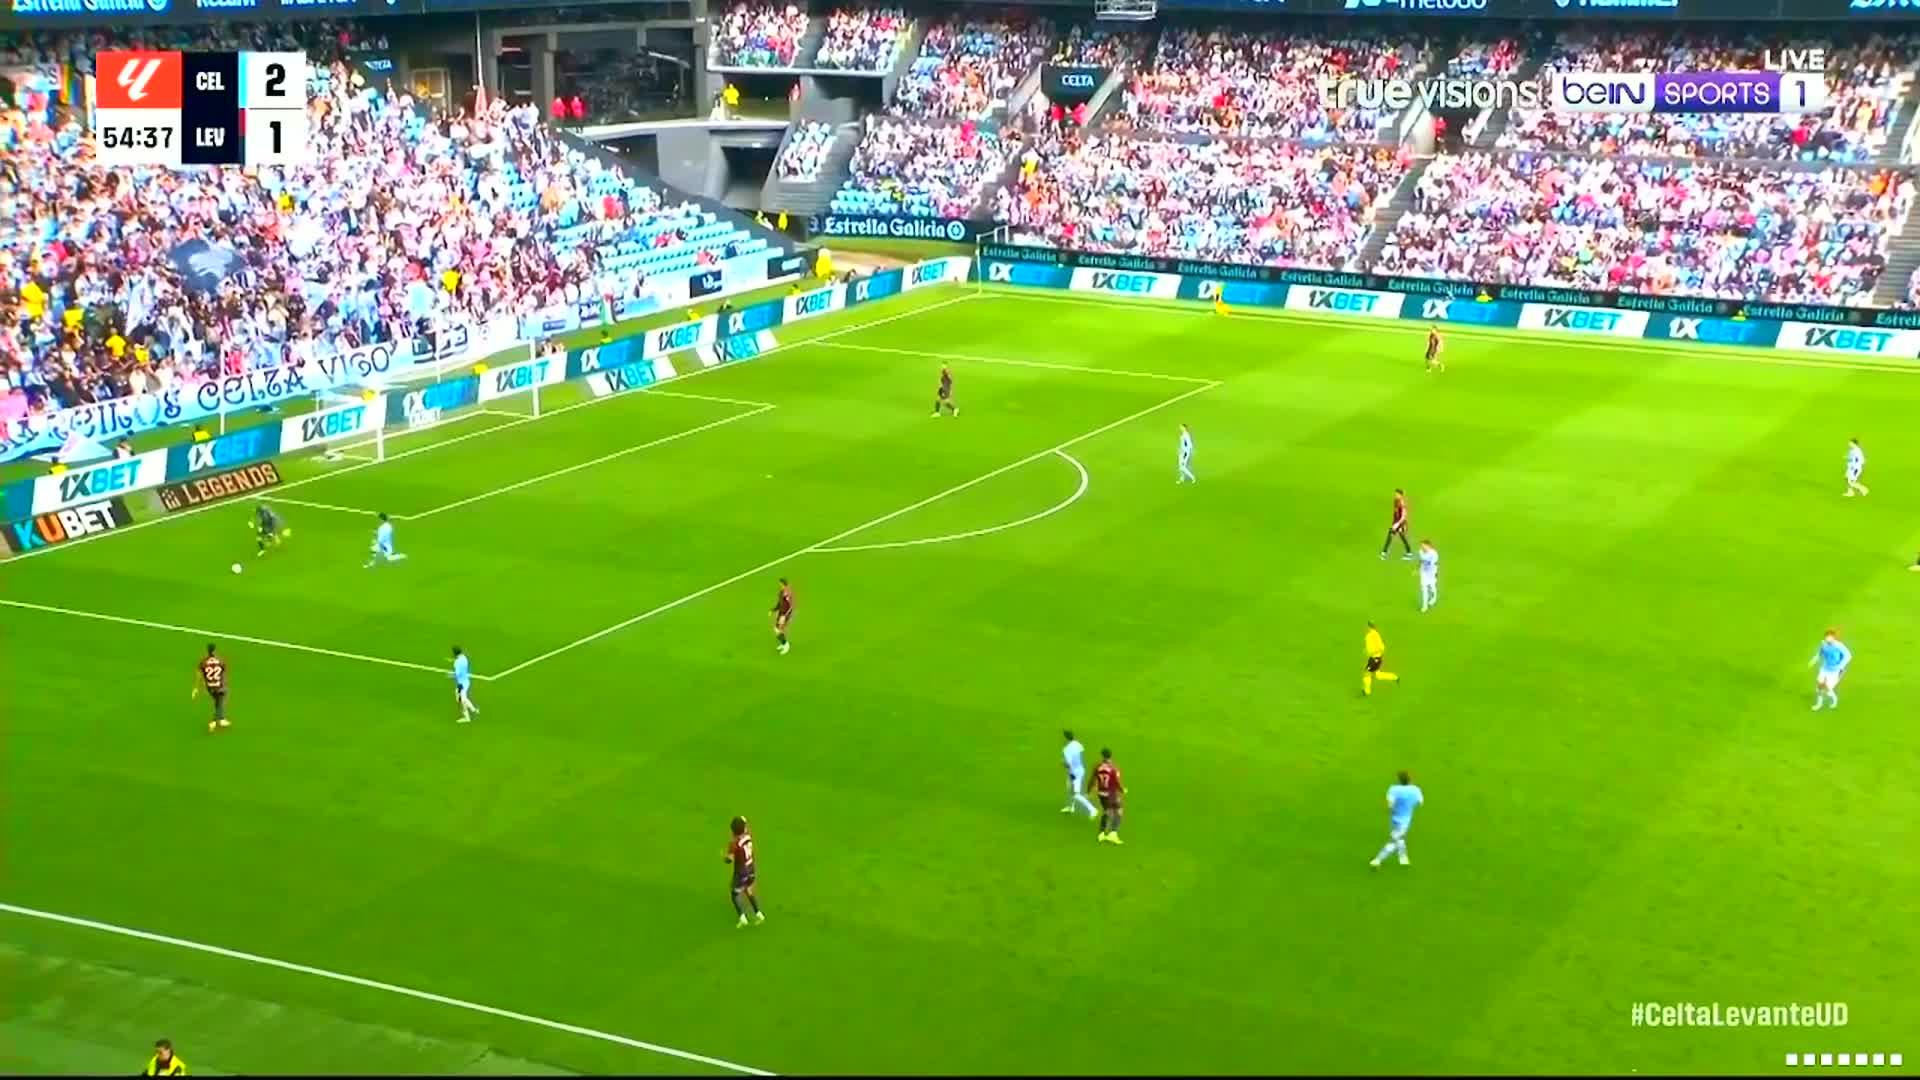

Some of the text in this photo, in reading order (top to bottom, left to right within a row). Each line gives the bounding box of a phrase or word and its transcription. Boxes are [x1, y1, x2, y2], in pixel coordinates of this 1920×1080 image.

[1062, 74, 1094, 86] CELTA
[824, 219, 946, 238] Estrella Galicia
[1091, 271, 1158, 293] 1XBET
[1308, 289, 1379, 312] 1XBET
[1543, 308, 1623, 331] 1XBET
[1805, 327, 1894, 352] 1XBET
[198, 360, 308, 412] CELTA
[301, 405, 366, 442] 1XBET
[60, 459, 142, 501] 1XBET
[182, 463, 279, 503] LEGENDS
[12, 501, 117, 550] KUBET
[205, 666, 222, 681] 22
